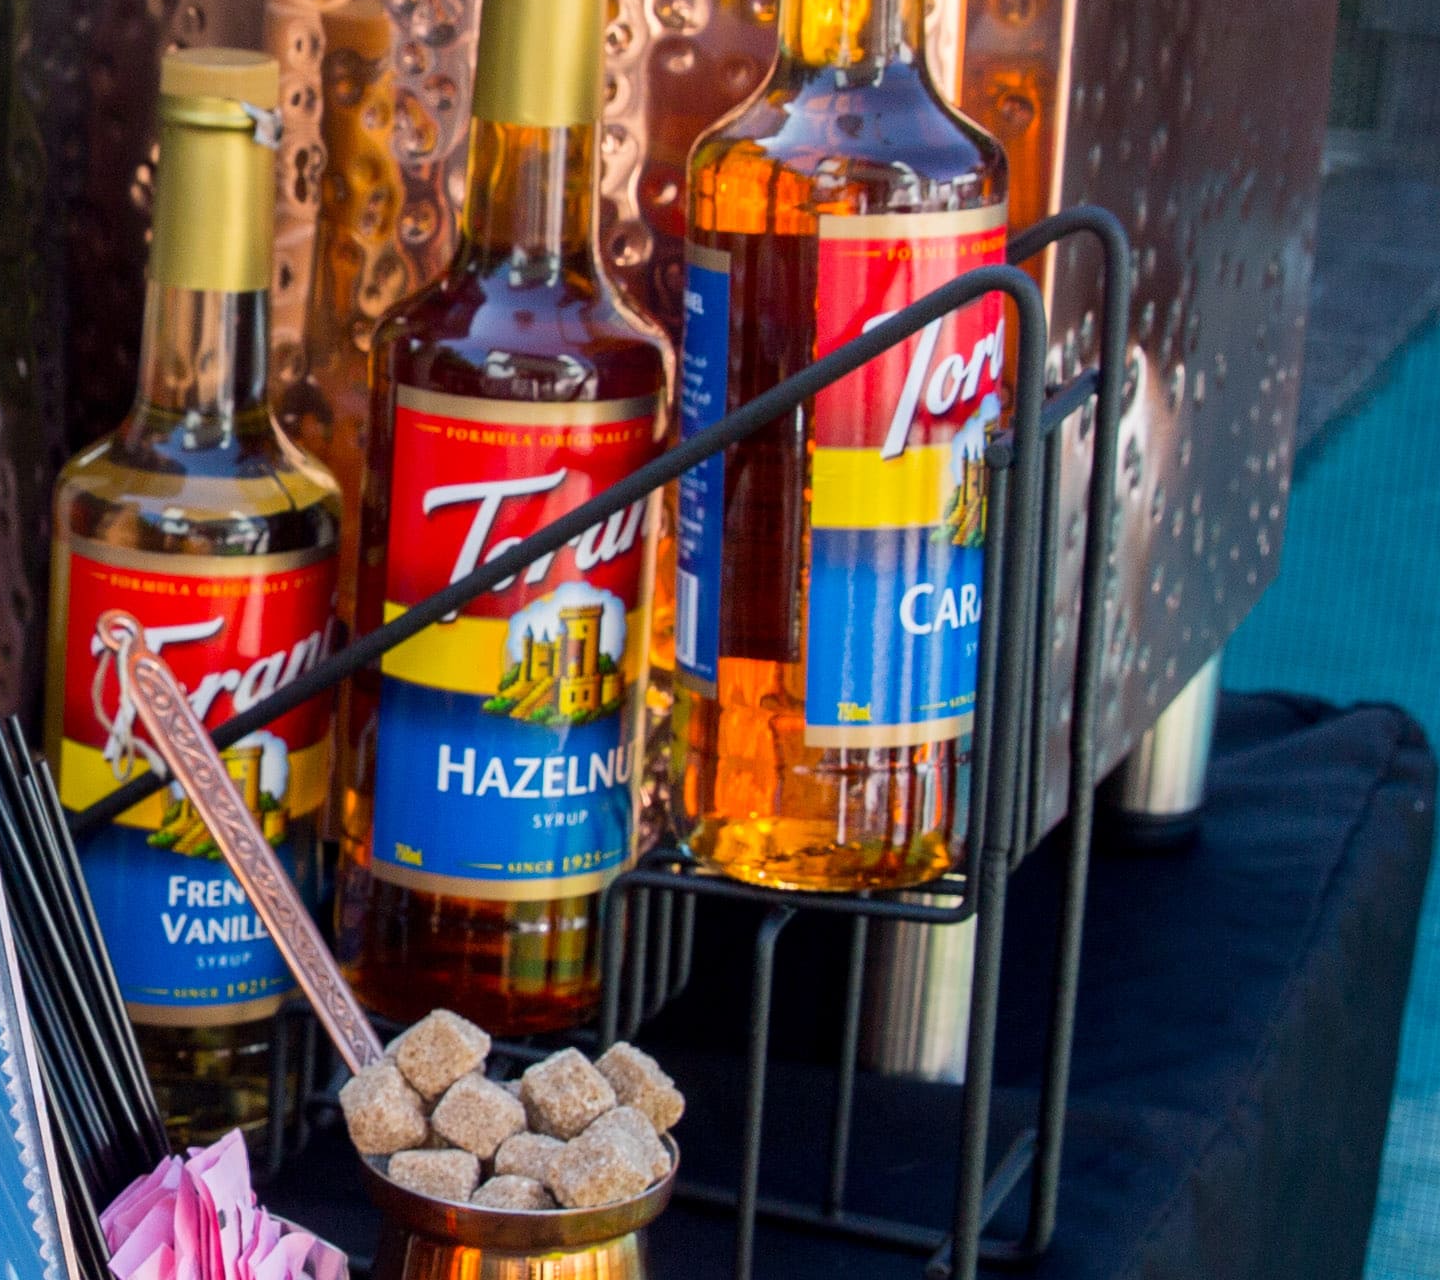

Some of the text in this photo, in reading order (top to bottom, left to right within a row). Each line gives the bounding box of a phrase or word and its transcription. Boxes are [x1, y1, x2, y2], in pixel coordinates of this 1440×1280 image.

[445, 425, 533, 447] FORMULA
[531, 808, 589, 830] SYRUP
[506, 858, 555, 875] SINCE
[168, 874, 246, 908] FREN
[160, 911, 271, 946] VANILL
[195, 950, 252, 970] SYRUP
